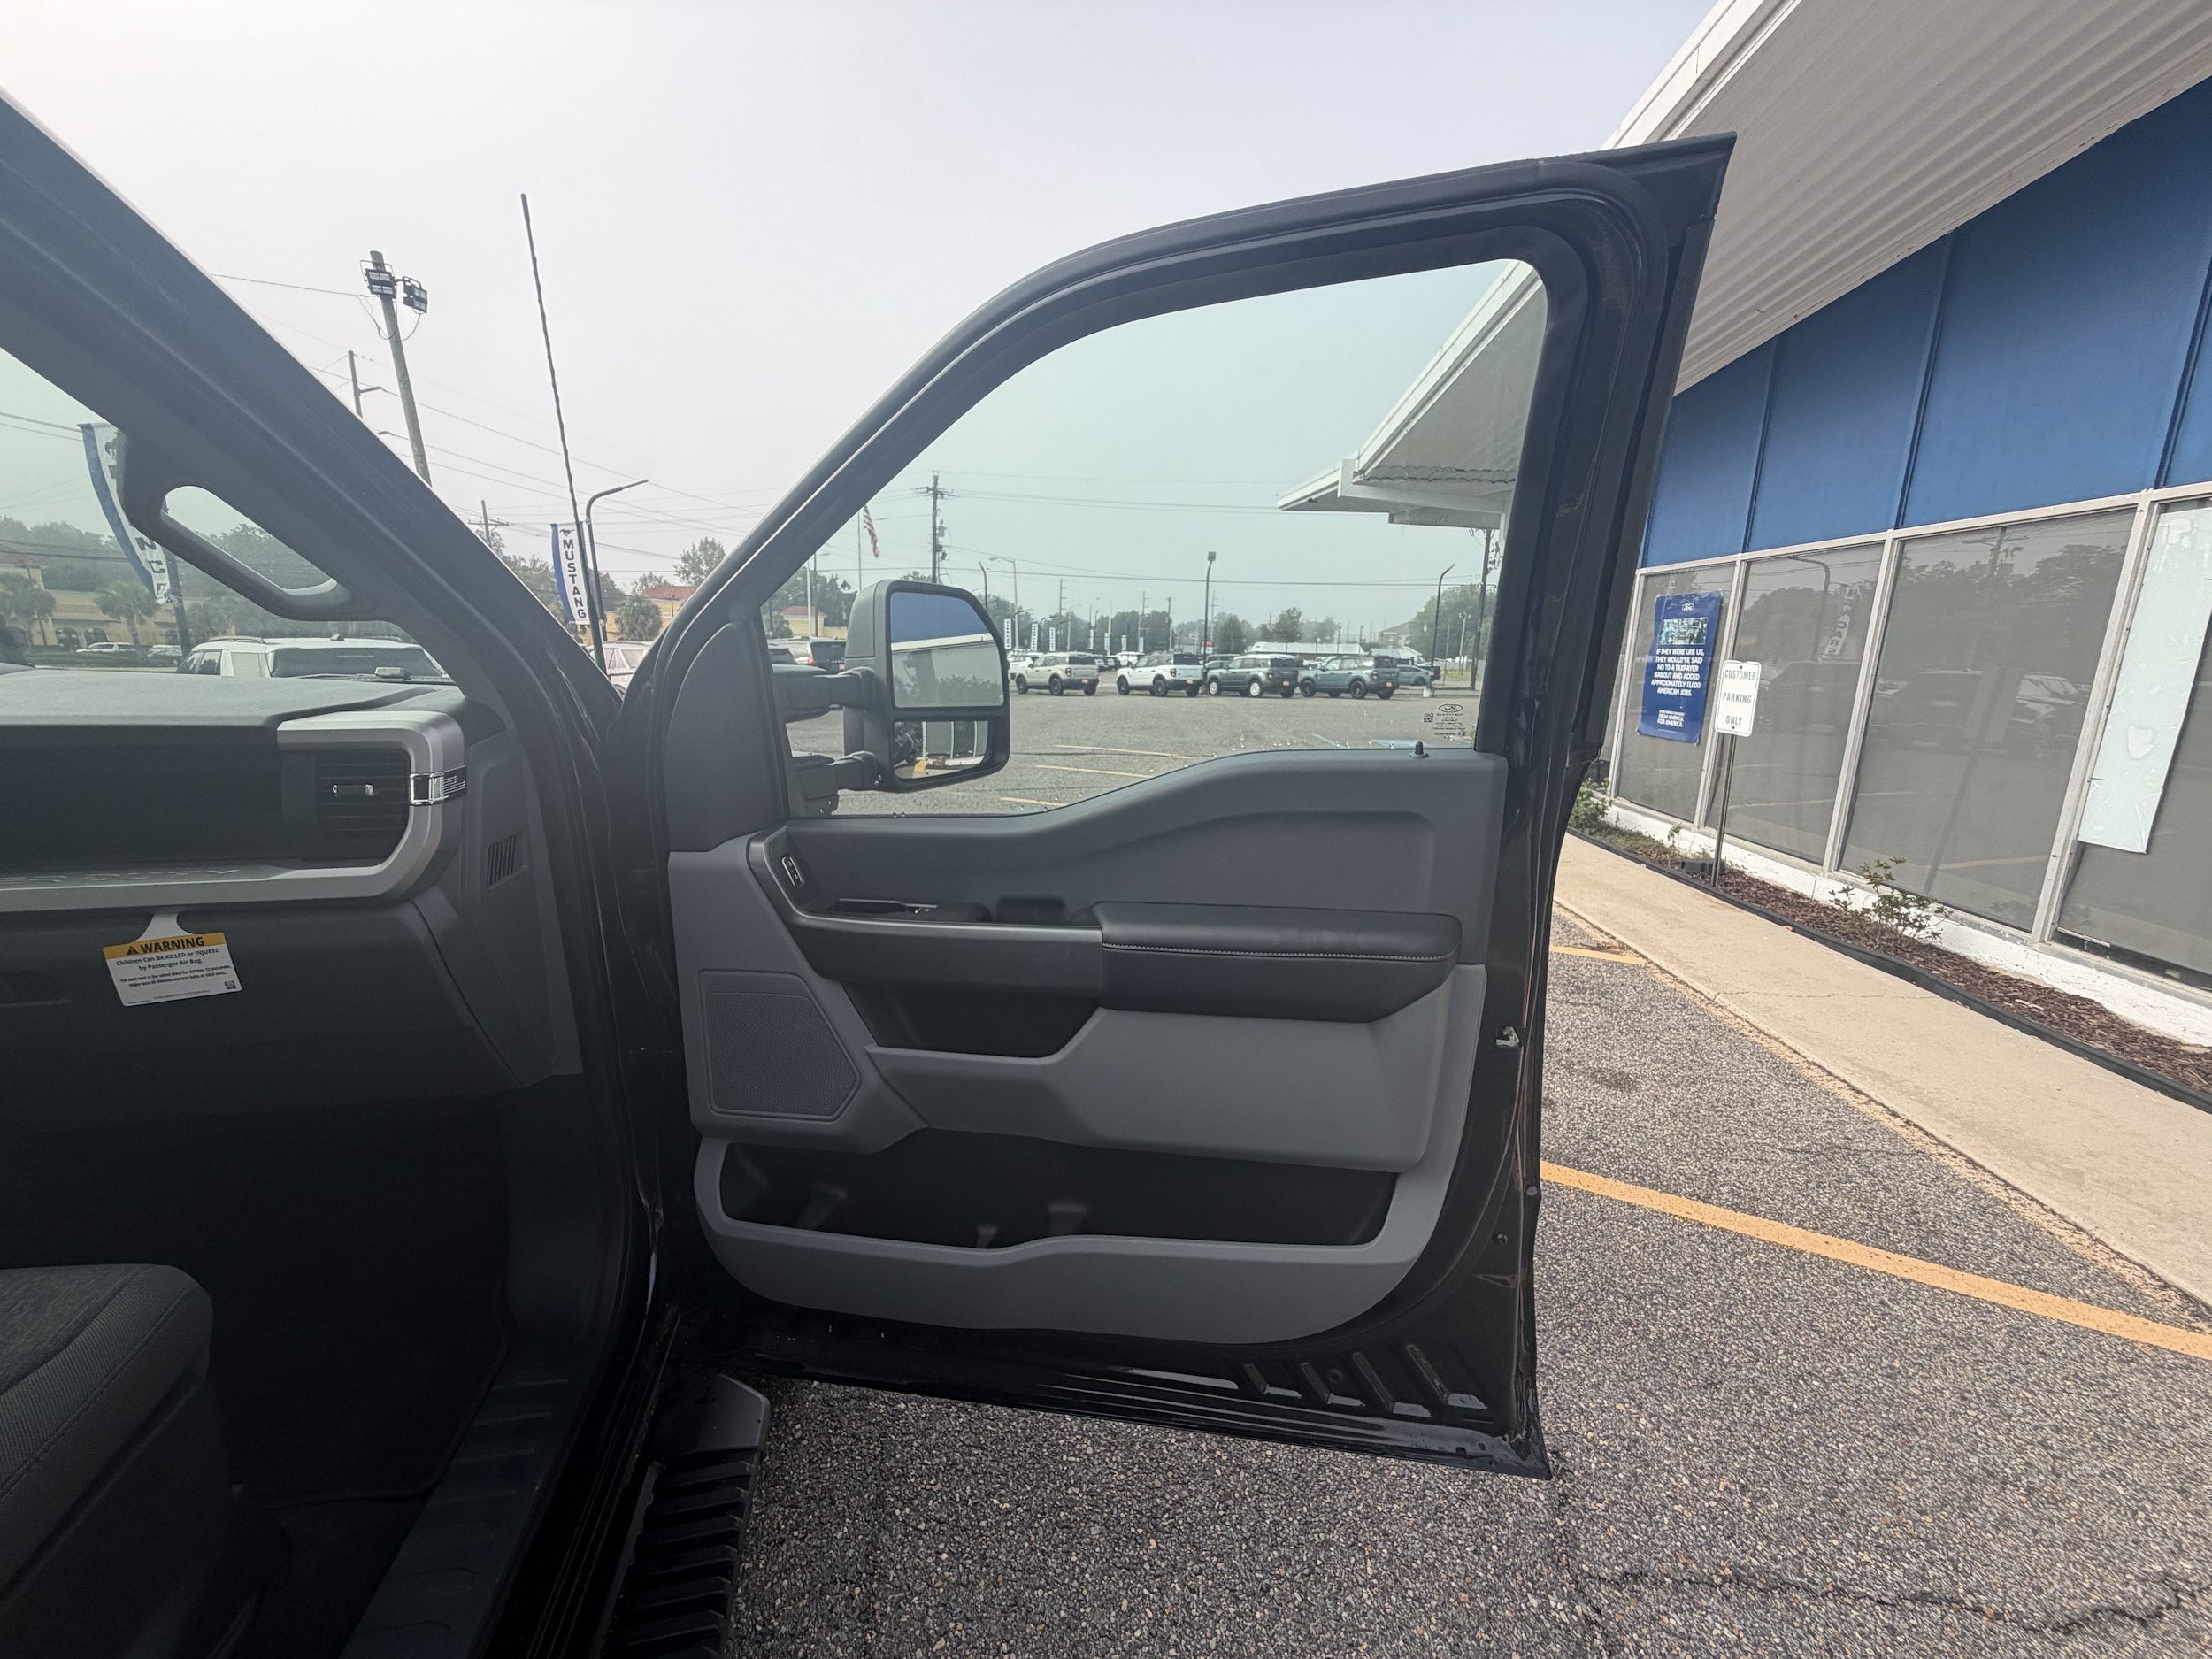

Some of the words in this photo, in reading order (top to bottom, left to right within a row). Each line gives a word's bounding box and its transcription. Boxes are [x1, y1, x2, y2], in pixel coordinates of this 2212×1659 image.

[563, 539, 587, 618] MUSTANG
[1724, 669, 1756, 680] CUSTOMER
[1651, 679, 1686, 687] APPROXIMATELY
[1657, 687, 1679, 695] AMERICAN
[1722, 692, 1752, 703] PARKING
[1725, 715, 1742, 726] ONLY
[140, 937, 204, 954] WARNING
